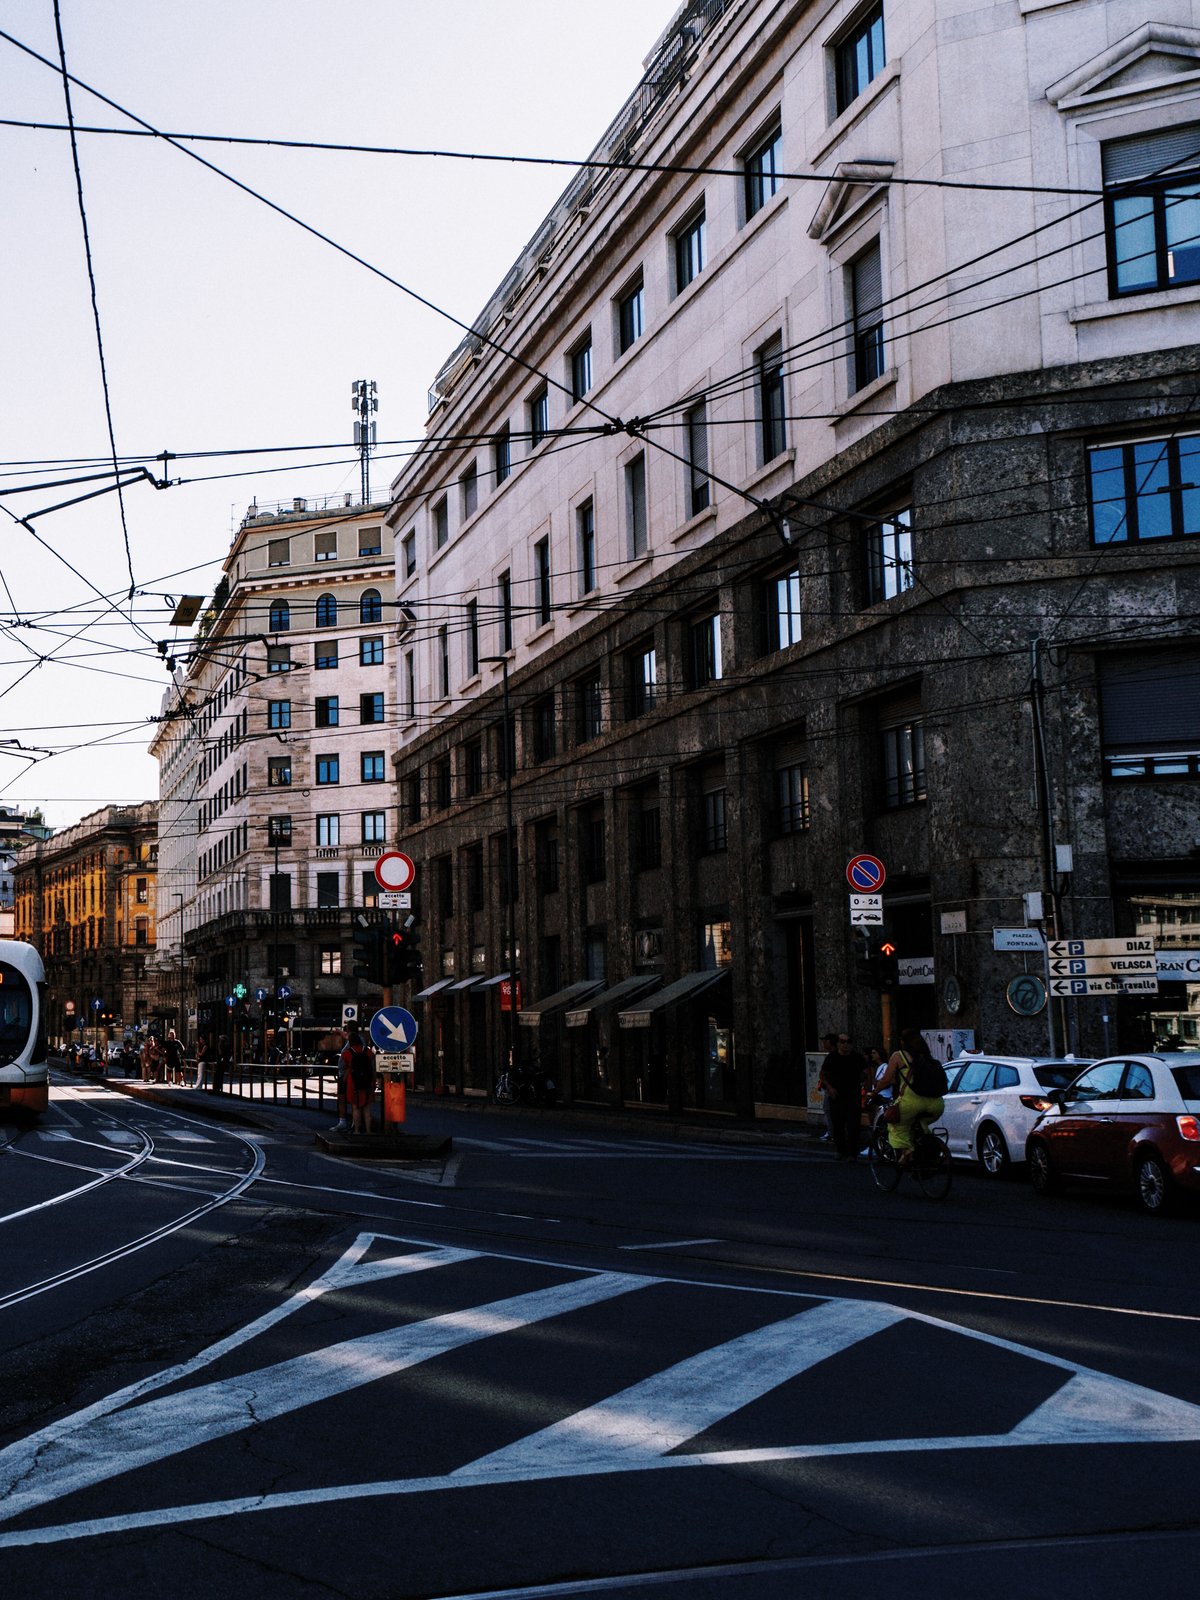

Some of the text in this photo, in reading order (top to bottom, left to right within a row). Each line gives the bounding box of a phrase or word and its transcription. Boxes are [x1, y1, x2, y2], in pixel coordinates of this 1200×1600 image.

[1126, 941, 1151, 951] DIAZ
[1111, 960, 1152, 970] VELASCA
[1089, 981, 1102, 991] via
[1105, 980, 1156, 991] Chiaravalle
